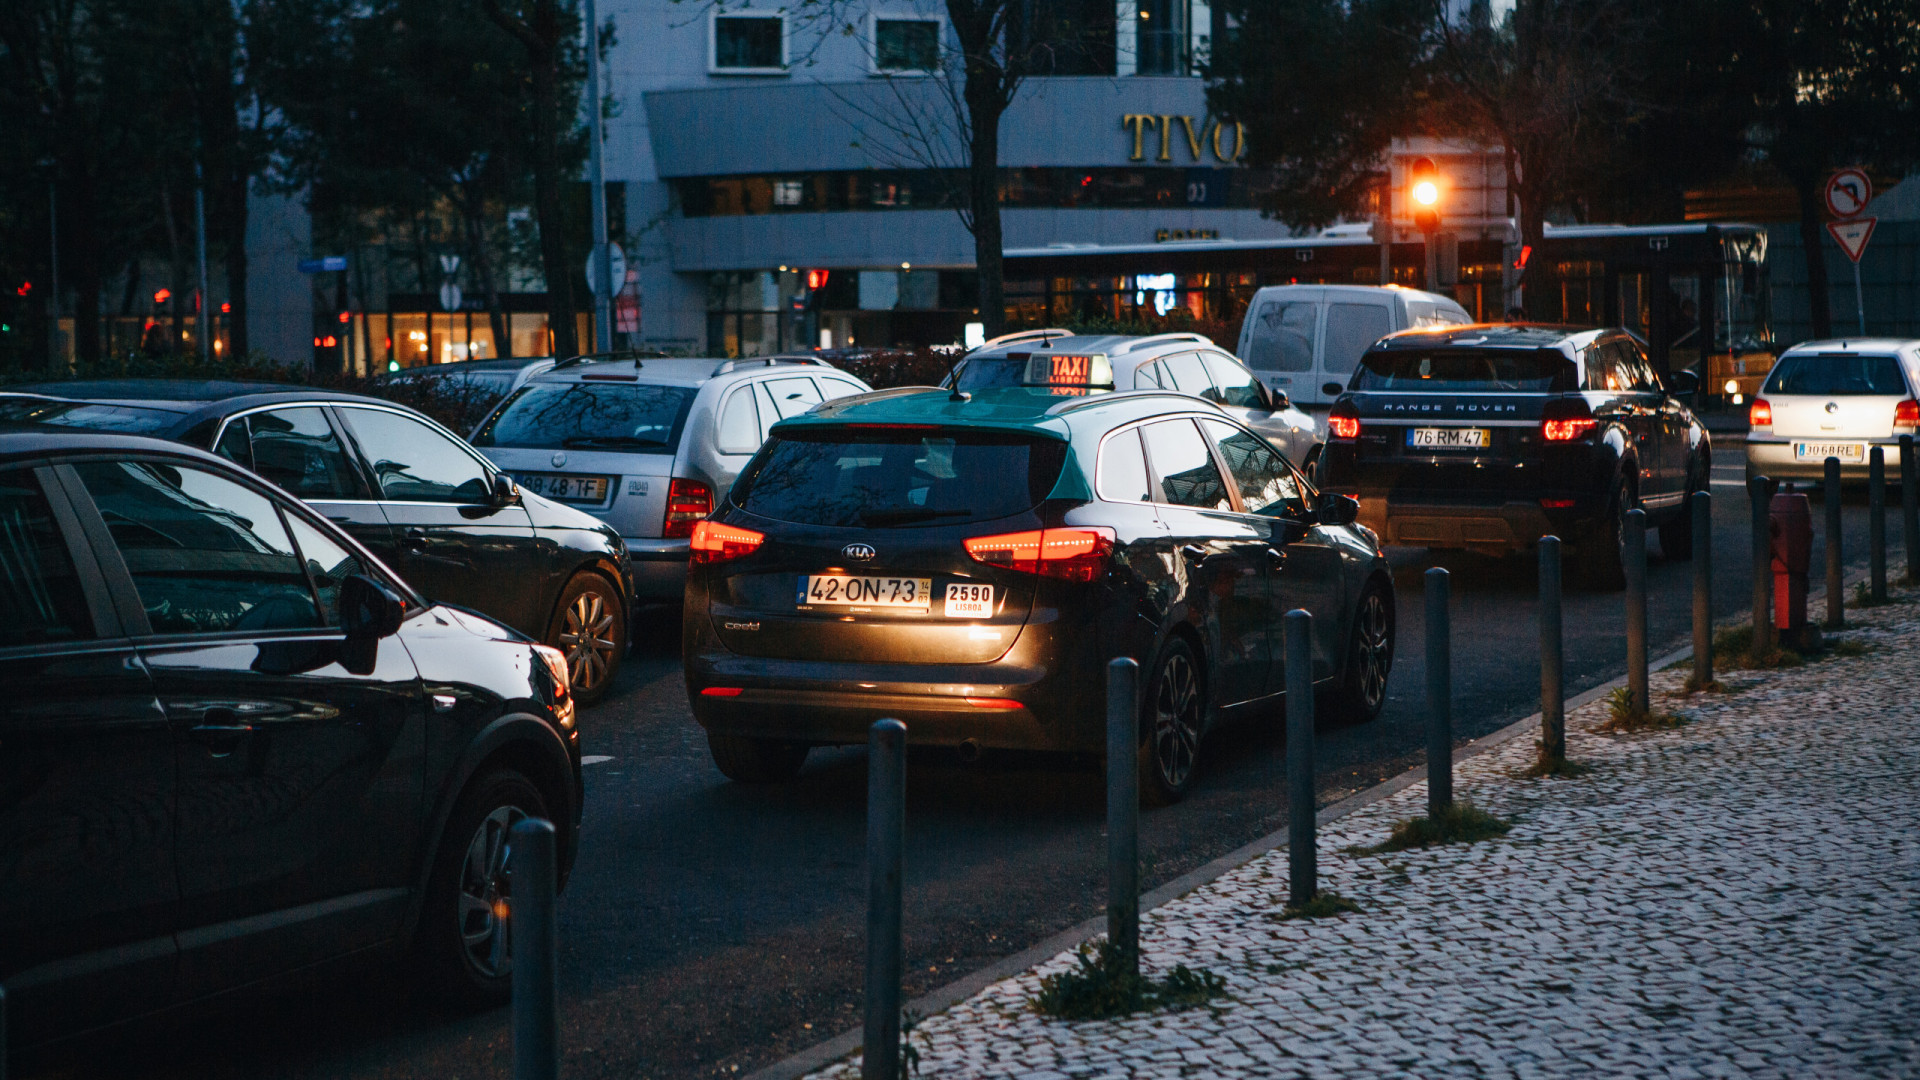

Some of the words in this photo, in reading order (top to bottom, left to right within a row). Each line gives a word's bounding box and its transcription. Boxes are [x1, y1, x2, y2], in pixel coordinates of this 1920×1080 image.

[1123, 114, 1246, 163] TIVO
[1051, 356, 1089, 376] TAXI
[1049, 376, 1088, 385] LISBOA
[1383, 404, 1442, 412] RANGE
[1456, 404, 1517, 412] ROVER
[846, 546, 870, 559] KIA
[811, 577, 916, 603] 42-ON-73
[949, 586, 990, 602] 2590
[955, 603, 982, 612] LISBOA
